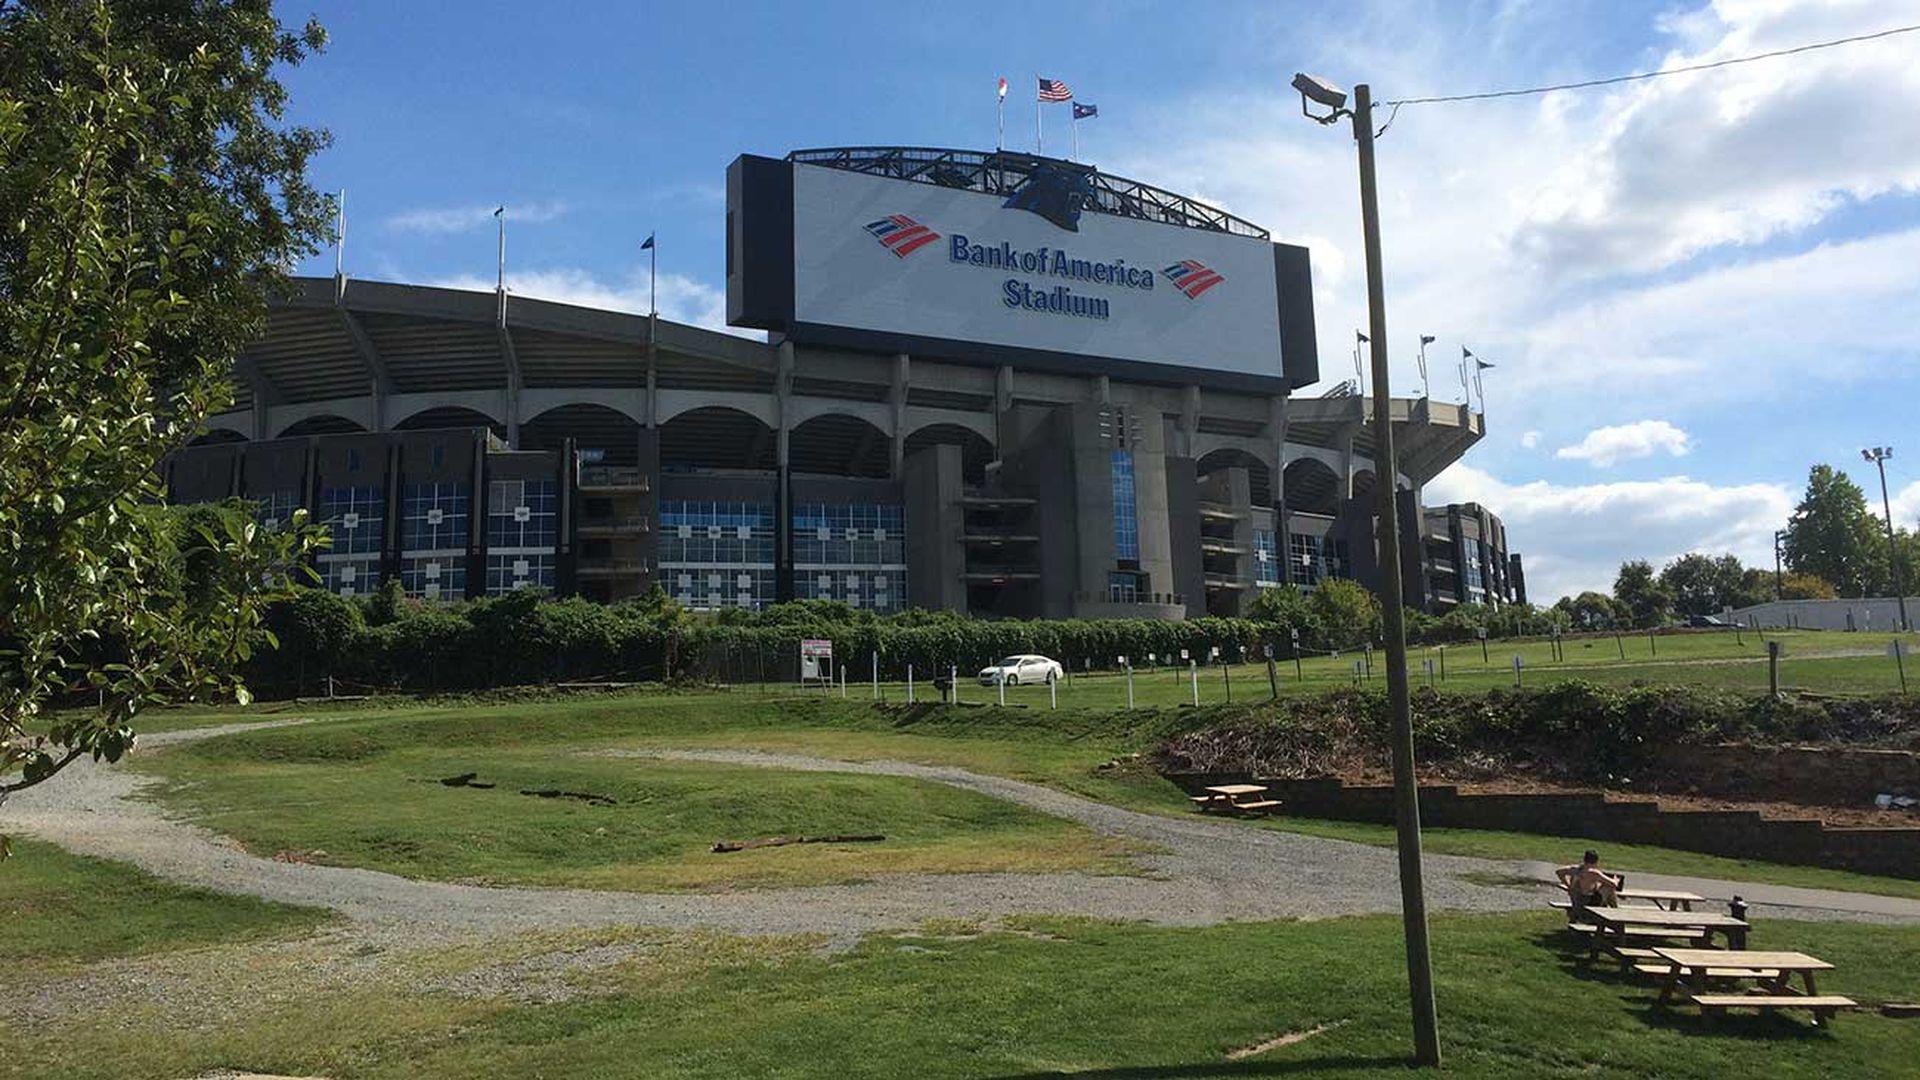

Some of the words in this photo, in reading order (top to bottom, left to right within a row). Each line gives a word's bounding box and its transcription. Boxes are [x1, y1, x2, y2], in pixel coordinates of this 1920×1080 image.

[951, 234, 1018, 269] Bank
[1021, 247, 1049, 274] of
[1053, 250, 1154, 289] America
[1003, 279, 1110, 319] Stadium
